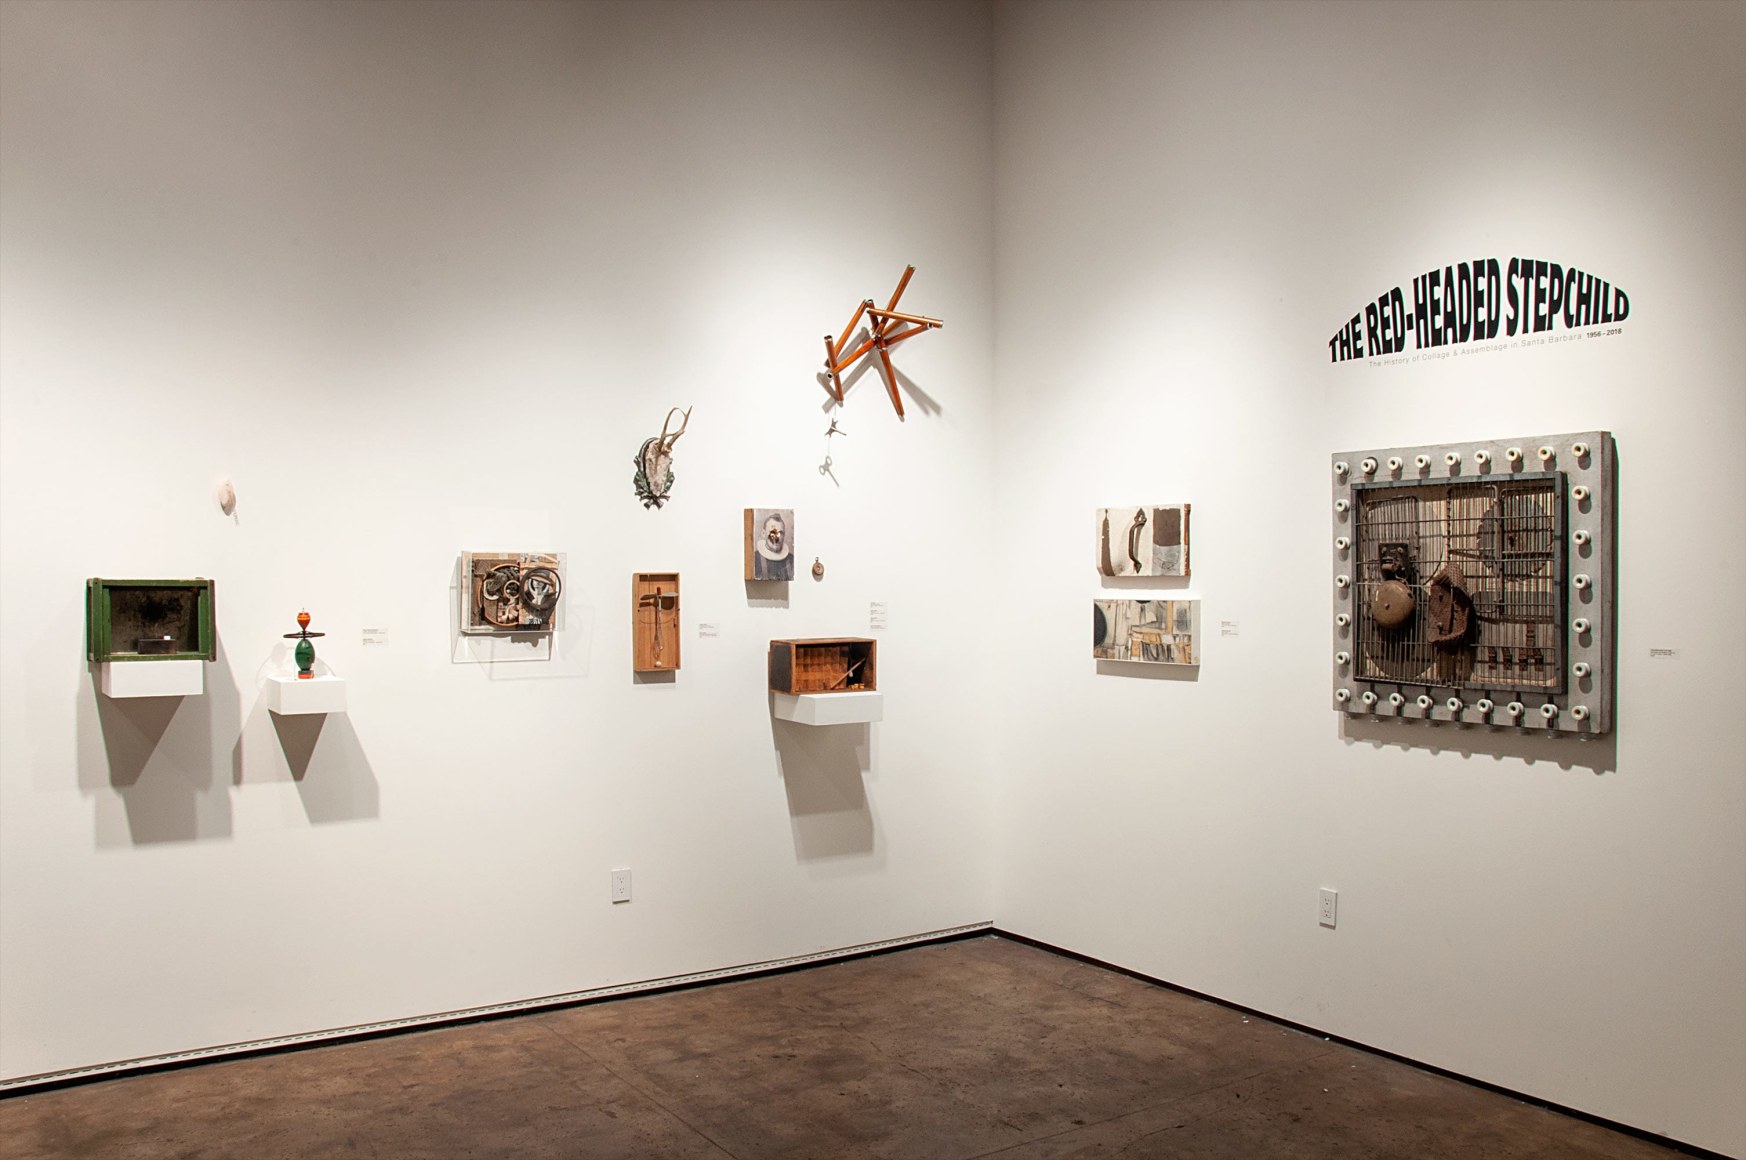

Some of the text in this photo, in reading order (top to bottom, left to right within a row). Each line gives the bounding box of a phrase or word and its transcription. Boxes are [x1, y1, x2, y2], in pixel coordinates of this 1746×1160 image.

[1329, 257, 1630, 363] THE RED-HEADED STEPCHILD
[1384, 357, 1409, 367] History
[1422, 351, 1450, 361] Collage
[1461, 344, 1508, 355] Assemblage
[1521, 338, 1545, 347] Santa
[1548, 333, 1582, 343] Barbara
[1586, 330, 1601, 339] 1956
[1606, 328, 1622, 336] 2018
